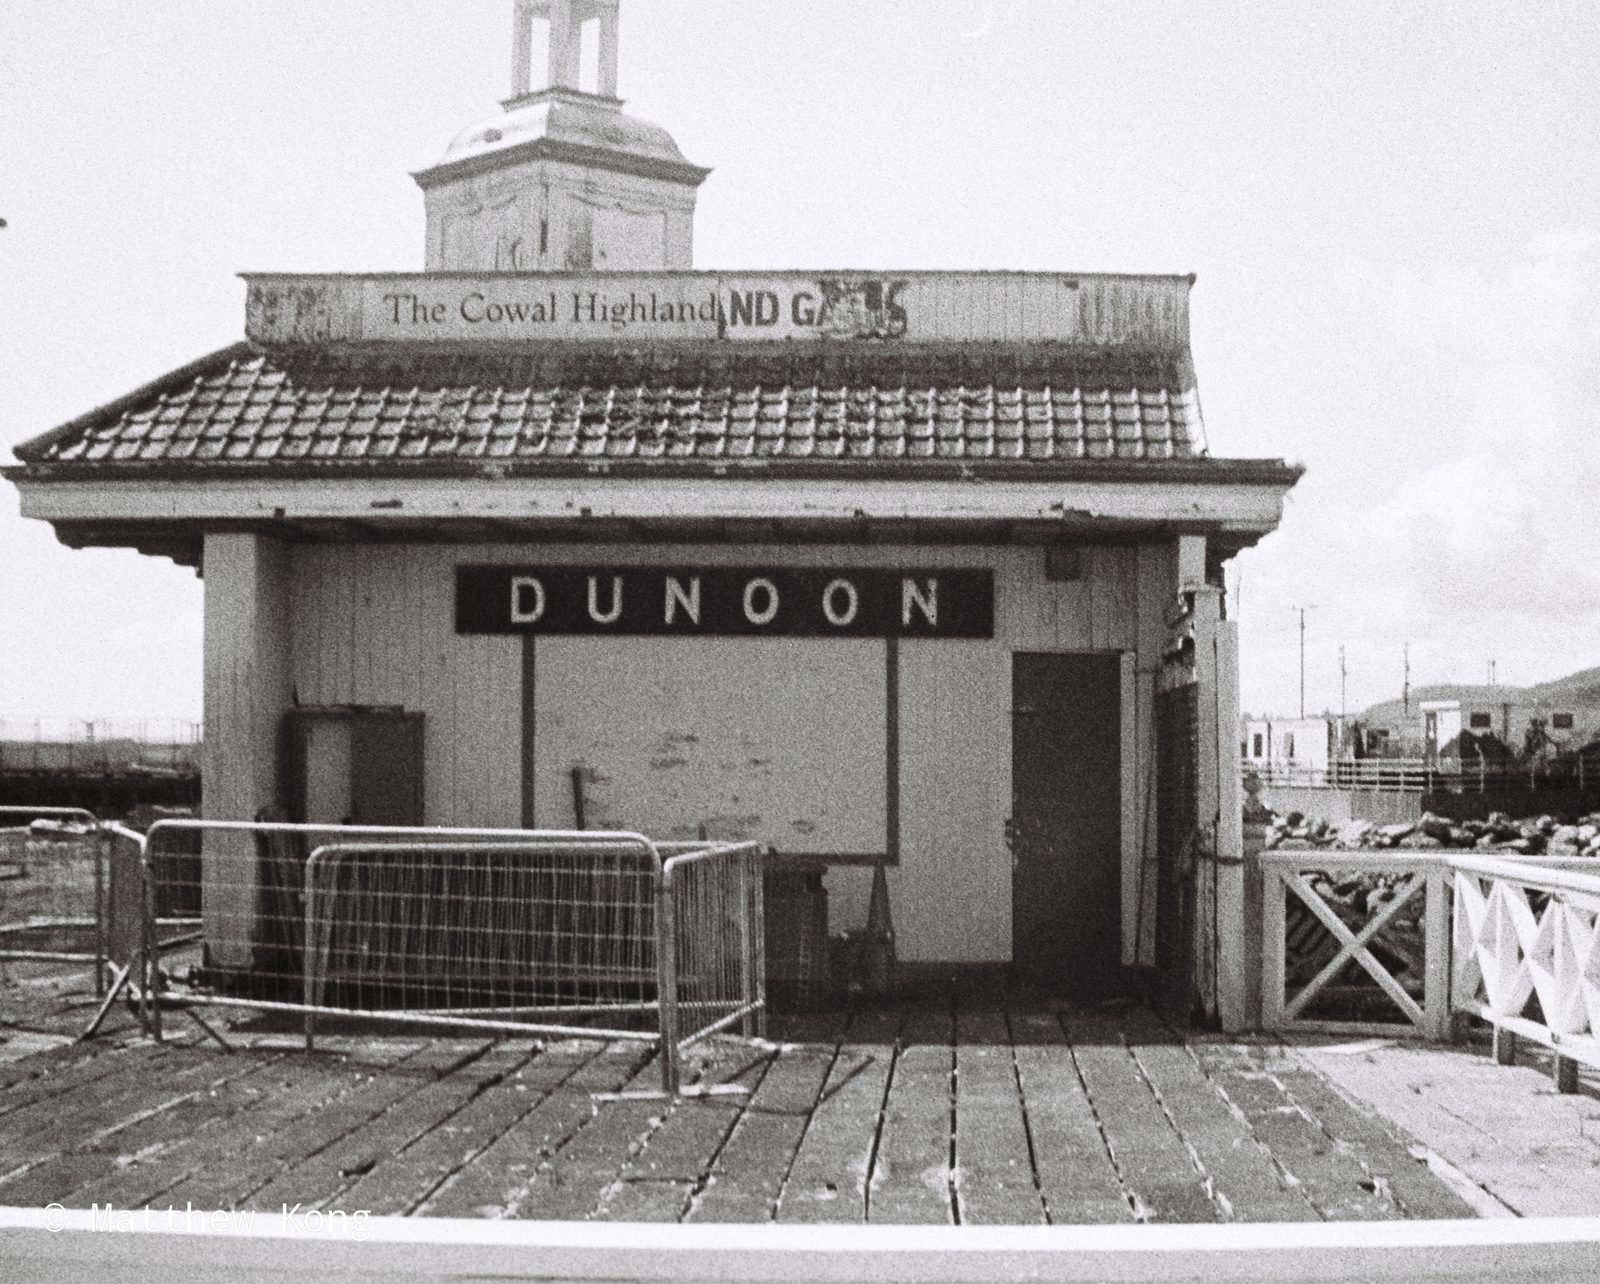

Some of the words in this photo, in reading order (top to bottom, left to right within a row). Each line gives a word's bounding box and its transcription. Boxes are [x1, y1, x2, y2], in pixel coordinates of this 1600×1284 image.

[382, 293, 447, 325] The
[459, 292, 557, 324] Cowal
[571, 292, 716, 331] Highland
[510, 576, 938, 626] DUNOON
